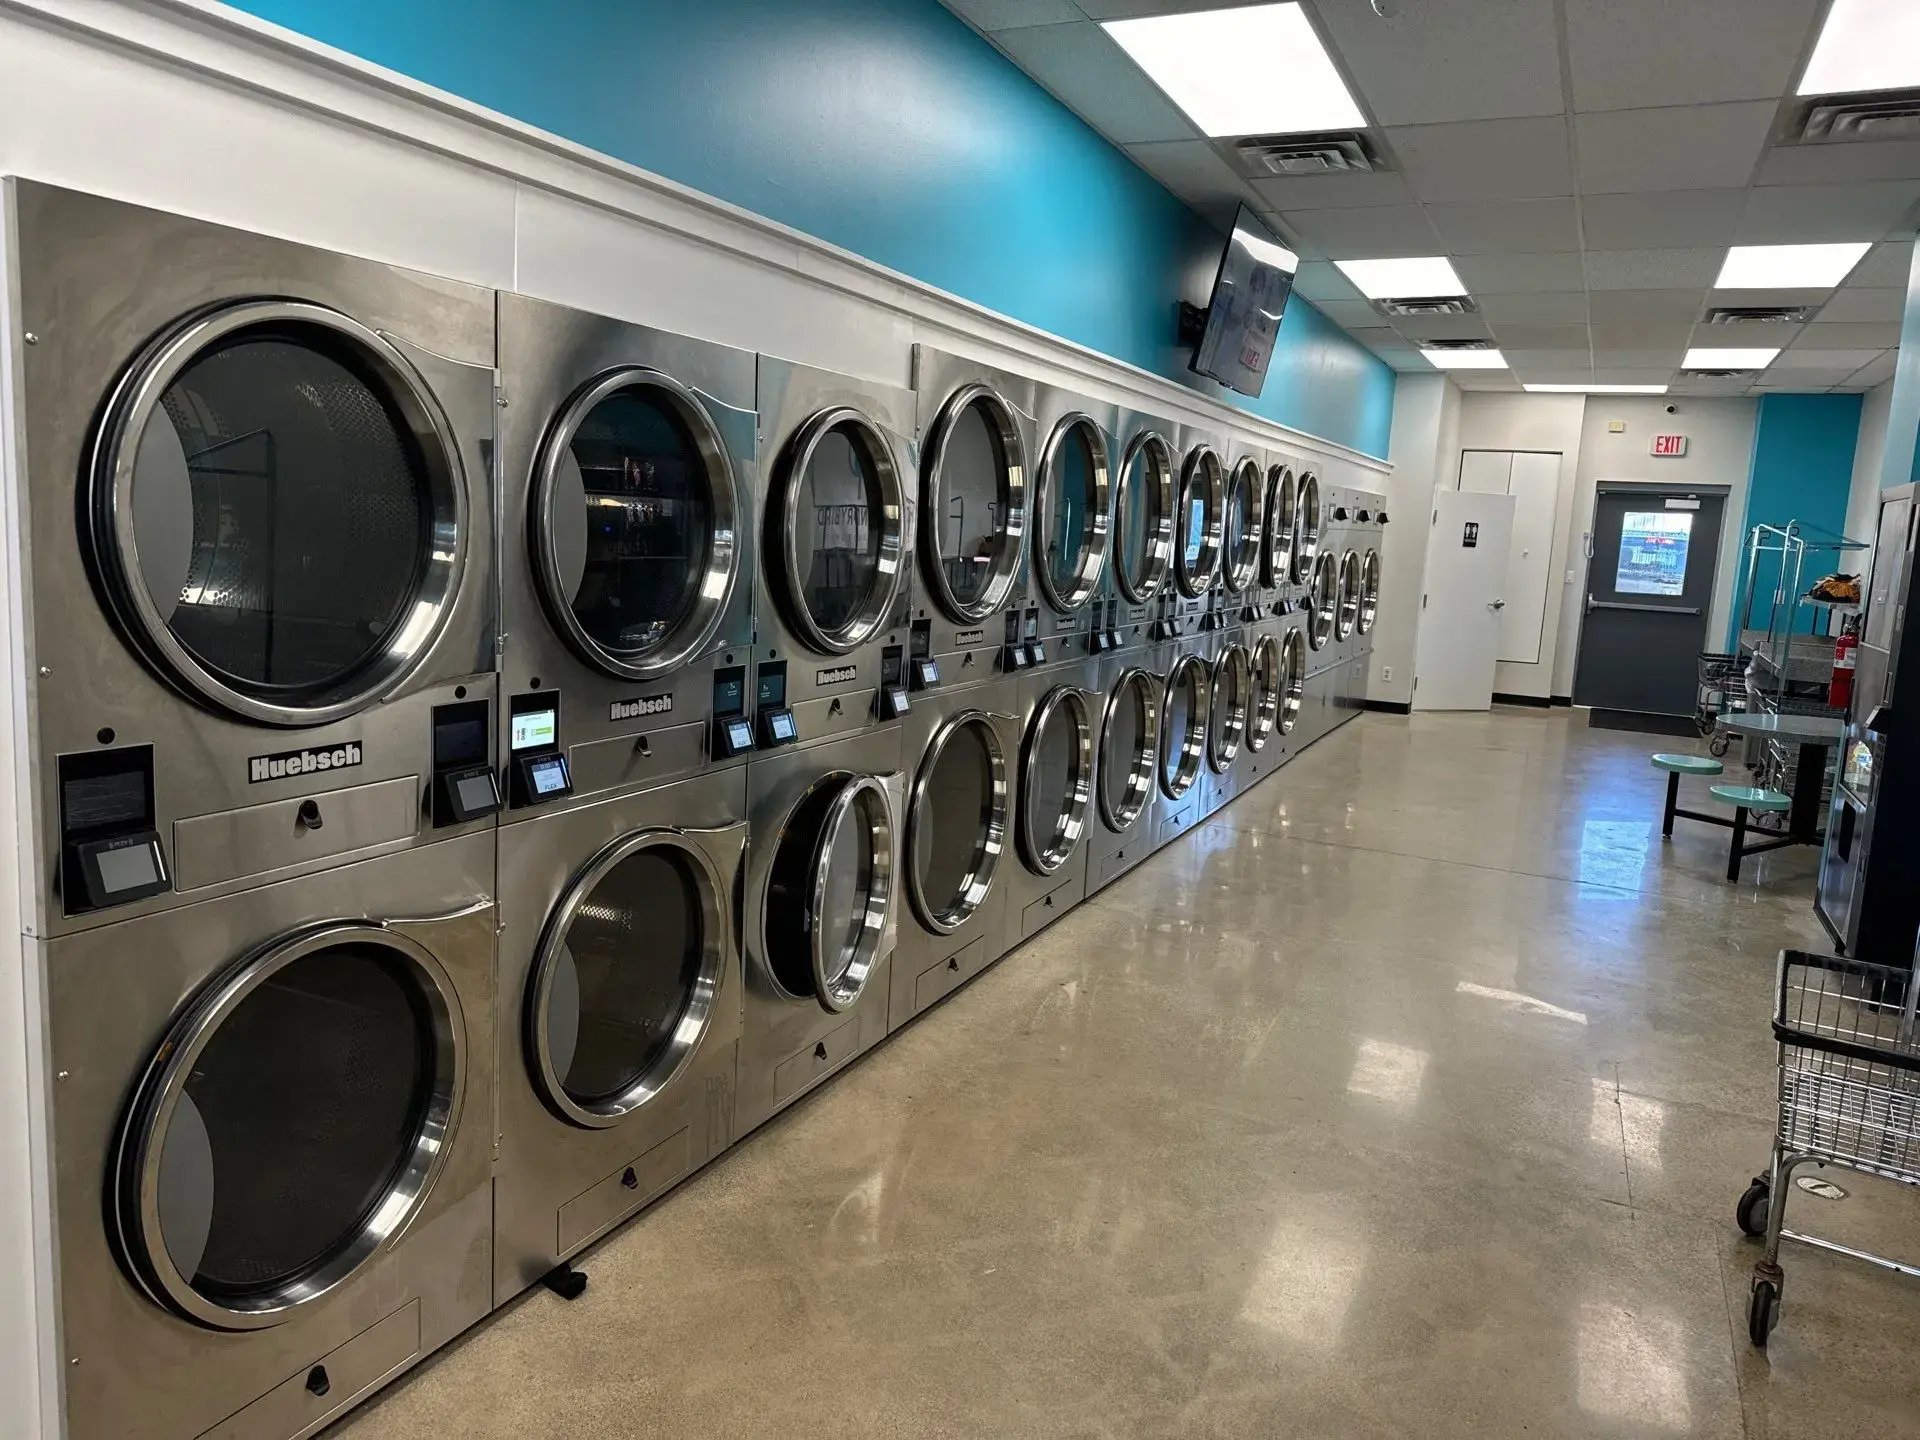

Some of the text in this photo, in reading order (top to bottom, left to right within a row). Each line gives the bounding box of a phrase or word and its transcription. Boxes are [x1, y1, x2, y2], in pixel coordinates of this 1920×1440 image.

[1656, 436, 1682, 453] EXIT
[818, 667, 856, 685] Huebsch
[611, 695, 672, 720] Huebsch
[251, 744, 360, 781] Huebsch
